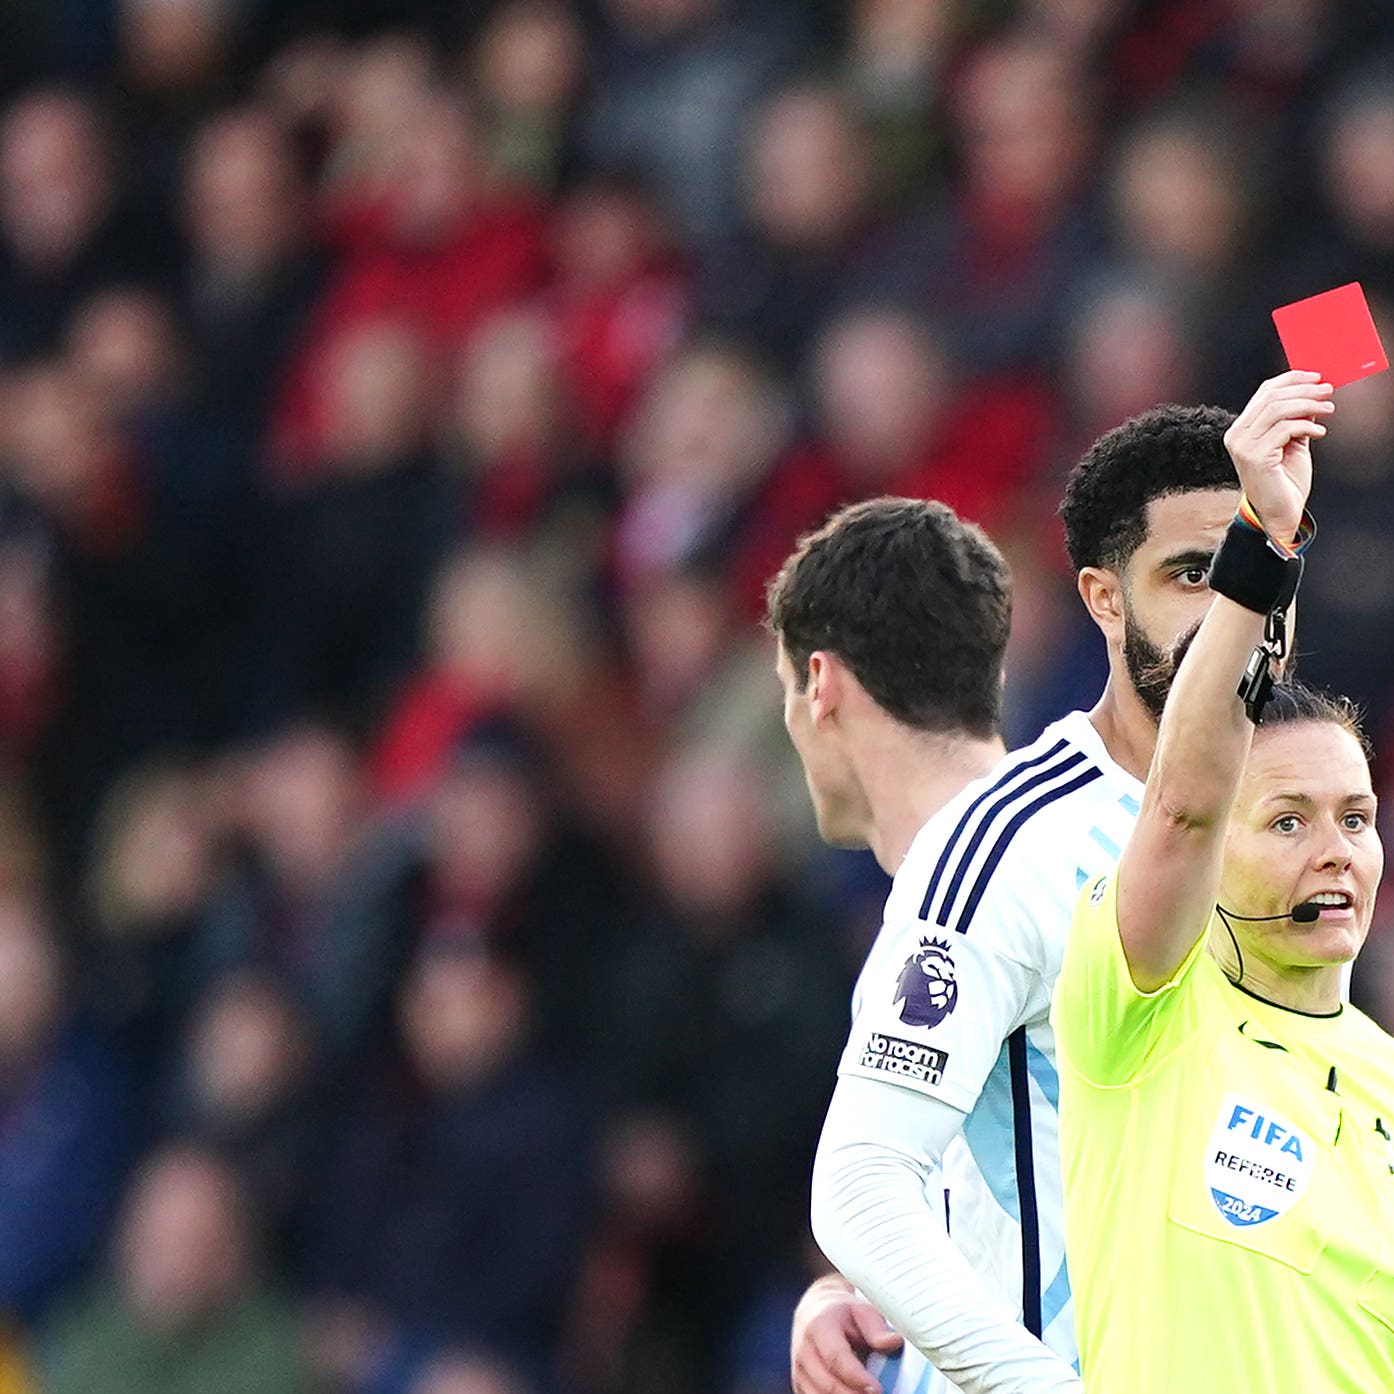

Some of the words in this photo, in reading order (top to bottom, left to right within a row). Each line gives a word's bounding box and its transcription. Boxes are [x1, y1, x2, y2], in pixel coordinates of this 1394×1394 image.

[887, 1041, 939, 1068] room
[1227, 1104, 1303, 1163] FIFA
[1214, 1150, 1297, 1192] REFEREE
